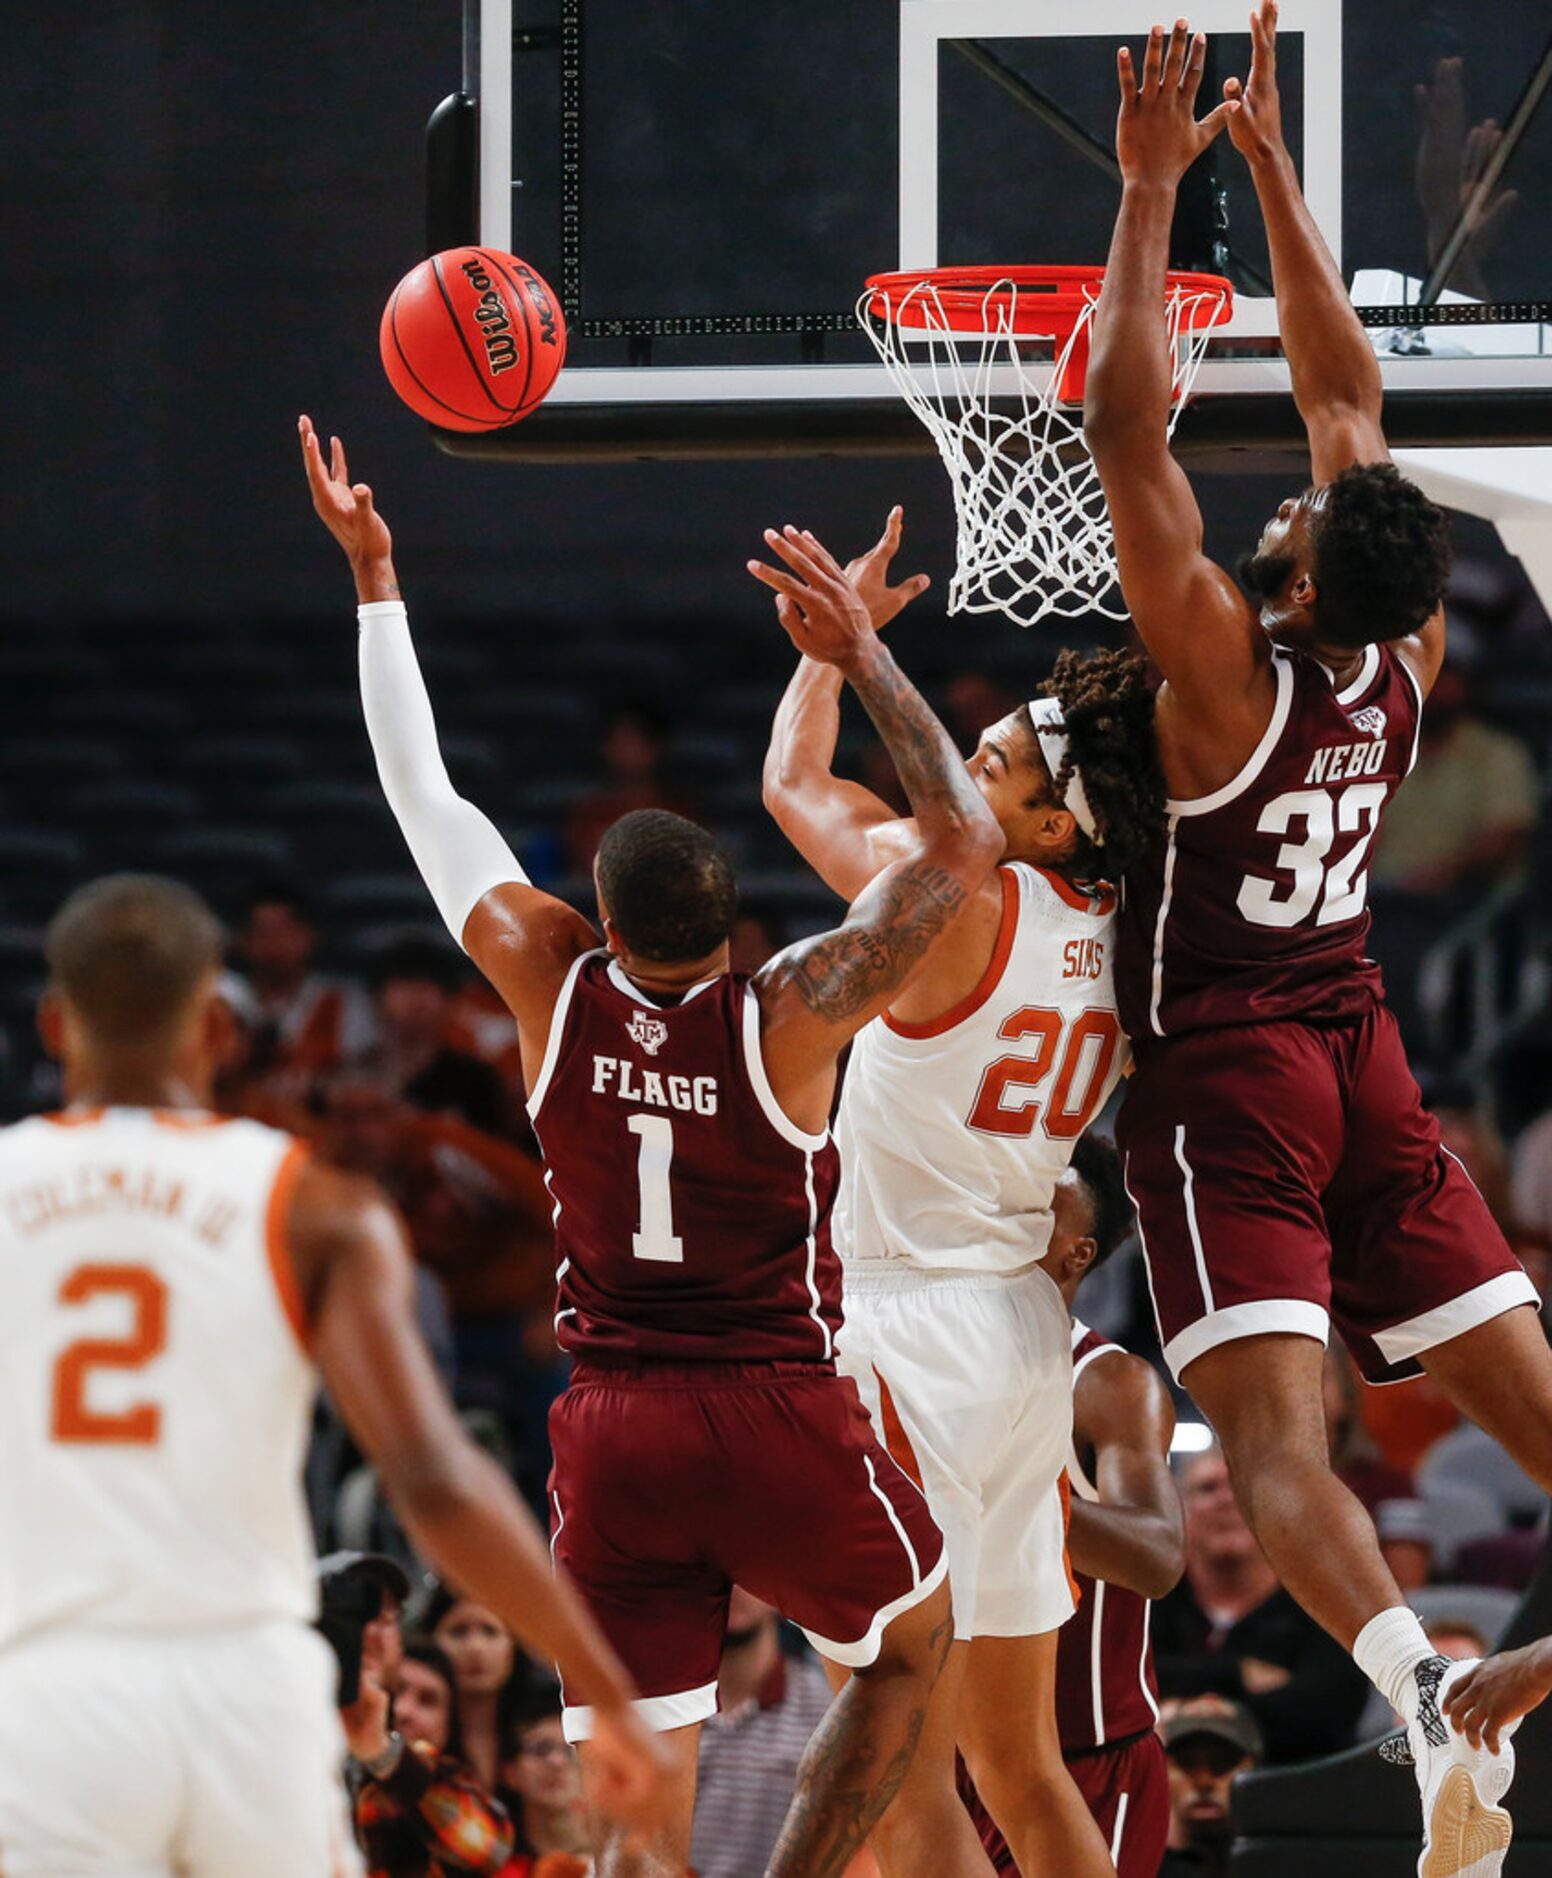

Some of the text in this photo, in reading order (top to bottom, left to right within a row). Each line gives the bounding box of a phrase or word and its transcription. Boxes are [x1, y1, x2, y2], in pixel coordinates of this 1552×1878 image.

[460, 258, 520, 377] Wilson
[1304, 738, 1388, 785] NEBO
[1236, 782, 1388, 928] 32
[1062, 938, 1104, 980] SIMS
[591, 1054, 718, 1117] FLAGG
[965, 1003, 1120, 1141] 20
[626, 1112, 684, 1263] 1
[50, 1262, 170, 1445] 2
